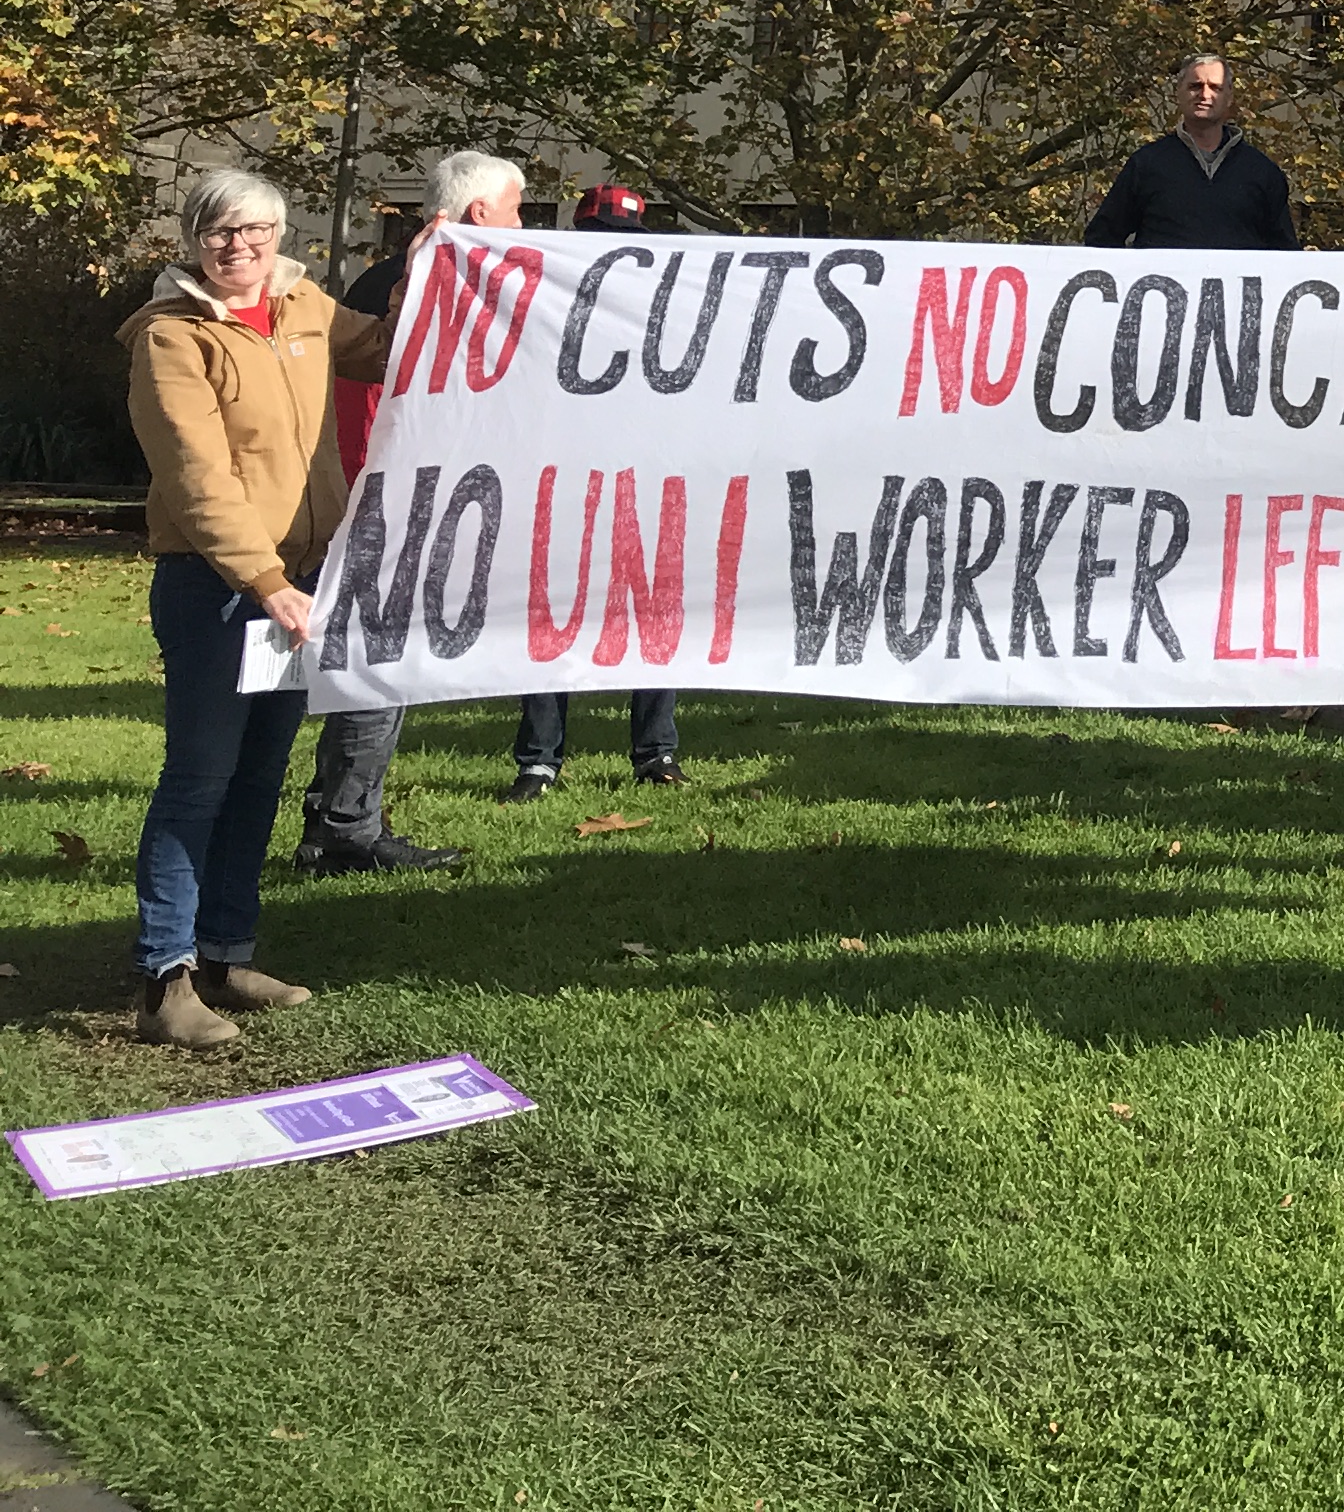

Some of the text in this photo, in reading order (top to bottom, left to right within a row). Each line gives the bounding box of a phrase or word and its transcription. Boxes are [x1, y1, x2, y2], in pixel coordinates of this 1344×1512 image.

[392, 244, 544, 398] NO
[556, 246, 885, 404] CUTS
[898, 266, 1028, 418] NO
[318, 464, 503, 672] NO
[527, 464, 749, 668] UNI
[786, 468, 1190, 666] WORKER
